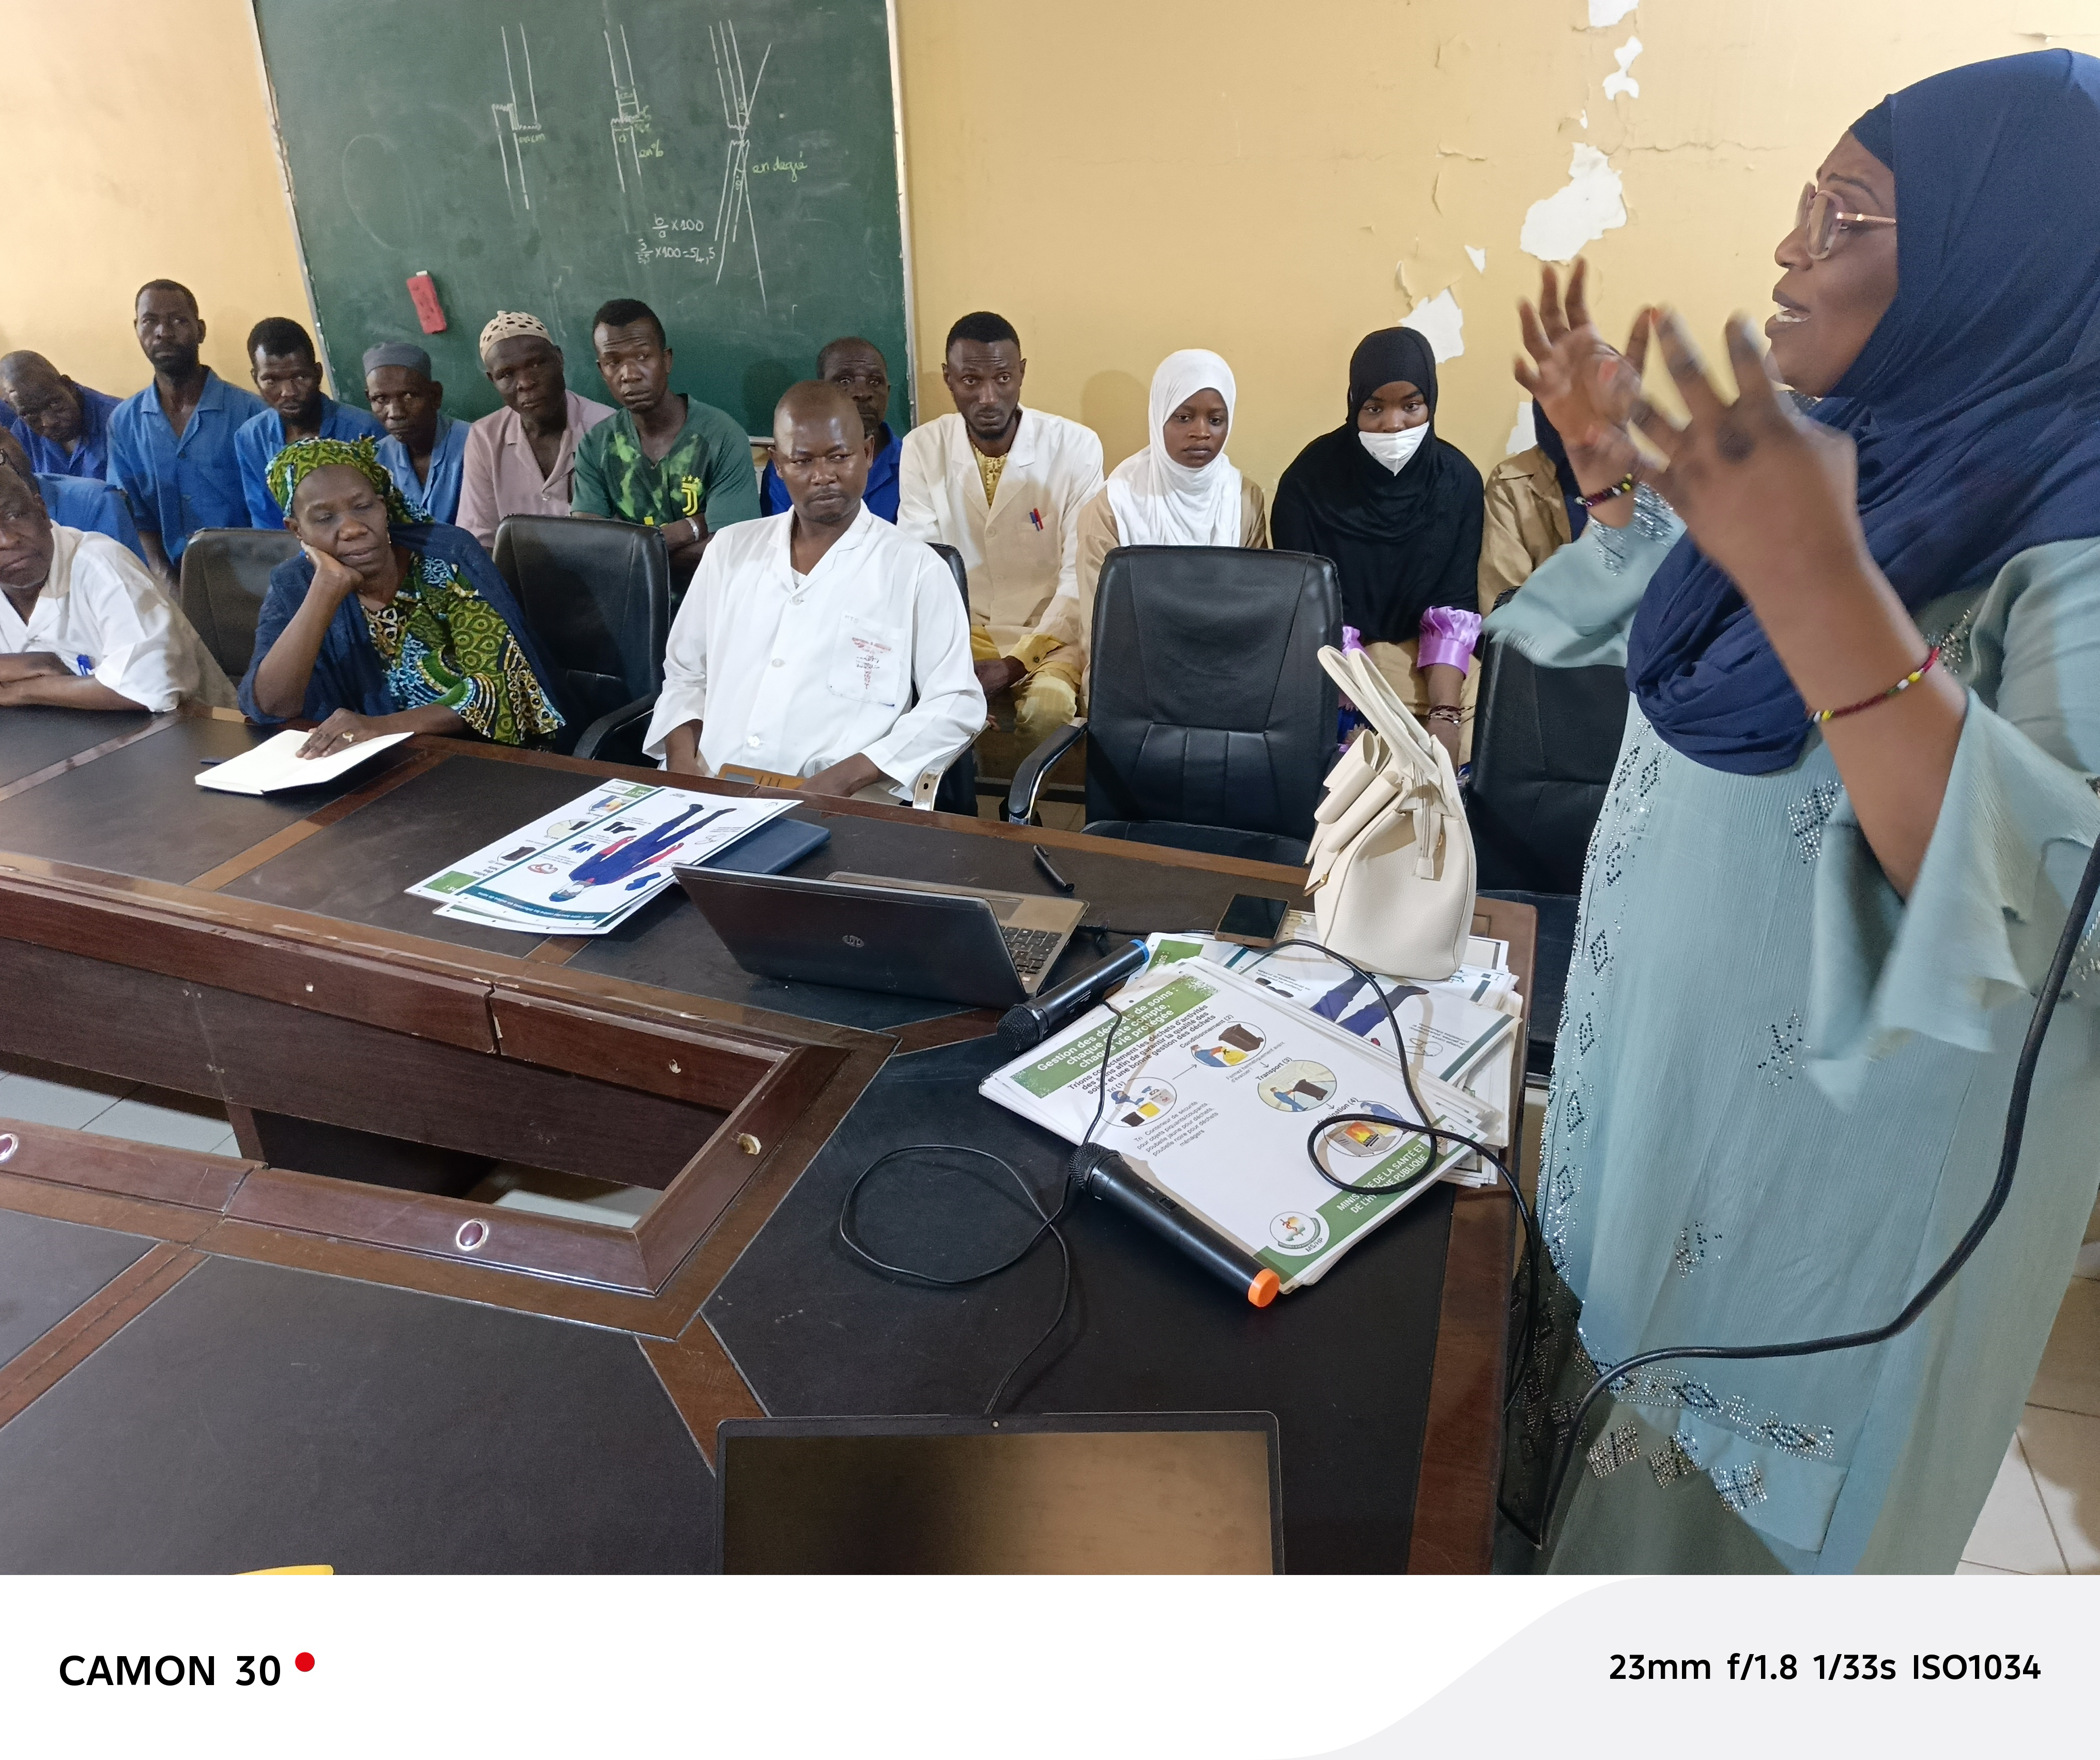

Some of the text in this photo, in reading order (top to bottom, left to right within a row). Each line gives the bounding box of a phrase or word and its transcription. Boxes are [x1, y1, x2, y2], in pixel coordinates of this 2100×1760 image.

[1155, 954, 1168, 965] ins
[1037, 1046, 1077, 1071] Gestion
[1077, 1035, 1097, 1052] des
[1134, 1005, 1148, 1015] de
[1148, 990, 1173, 1006] soins
[1067, 1041, 1103, 1065] chaque
[1131, 1004, 1171, 1028] compte,
[1068, 1005, 1208, 1090] Trions coectement les déchets d'activités
[1079, 1010, 1174, 1069] chaqe vie protégée
[1116, 1068, 1130, 1077] une
[1131, 1055, 1152, 1070] bonne
[1152, 1038, 1177, 1057] gestion
[1177, 1031, 1190, 1042] des
[1190, 1015, 1216, 1035] déchets
[1180, 1019, 1226, 1048] Conditionnement
[1082, 1079, 1097, 1090] des
[1097, 1069, 1116, 1083] sins
[1115, 1058, 1131, 1070] afin
[1131, 1051, 1140, 1060] de
[1139, 1037, 1167, 1057] garantir
[1173, 1018, 1196, 1036] qualité
[1196, 1012, 1209, 1022] des
[1255, 1056, 1293, 1081] Transport (3)
[1106, 1080, 1126, 1094] Tri (1)
[1347, 1097, 1359, 1106] (4)
[1137, 1140, 1149, 1150] pour
[1145, 1137, 1168, 1153] poubelle
[1181, 1119, 1194, 1130] pour
[1152, 1141, 1175, 1157] poubelle
[1187, 1124, 1199, 1135] pour
[1199, 1111, 1219, 1126] déchets
[1179, 1130, 1205, 1147] ménagers
[1373, 1173, 1386, 1184] DE
[1382, 1168, 1395, 1177] LA
[1392, 1149, 1417, 1169] SANTÉ
[1413, 1144, 1425, 1153] ET
[1350, 1202, 1364, 1214] DE
[1395, 1153, 1428, 1181] PUBLIQUE
[1305, 1238, 1323, 1252] MS/HP
